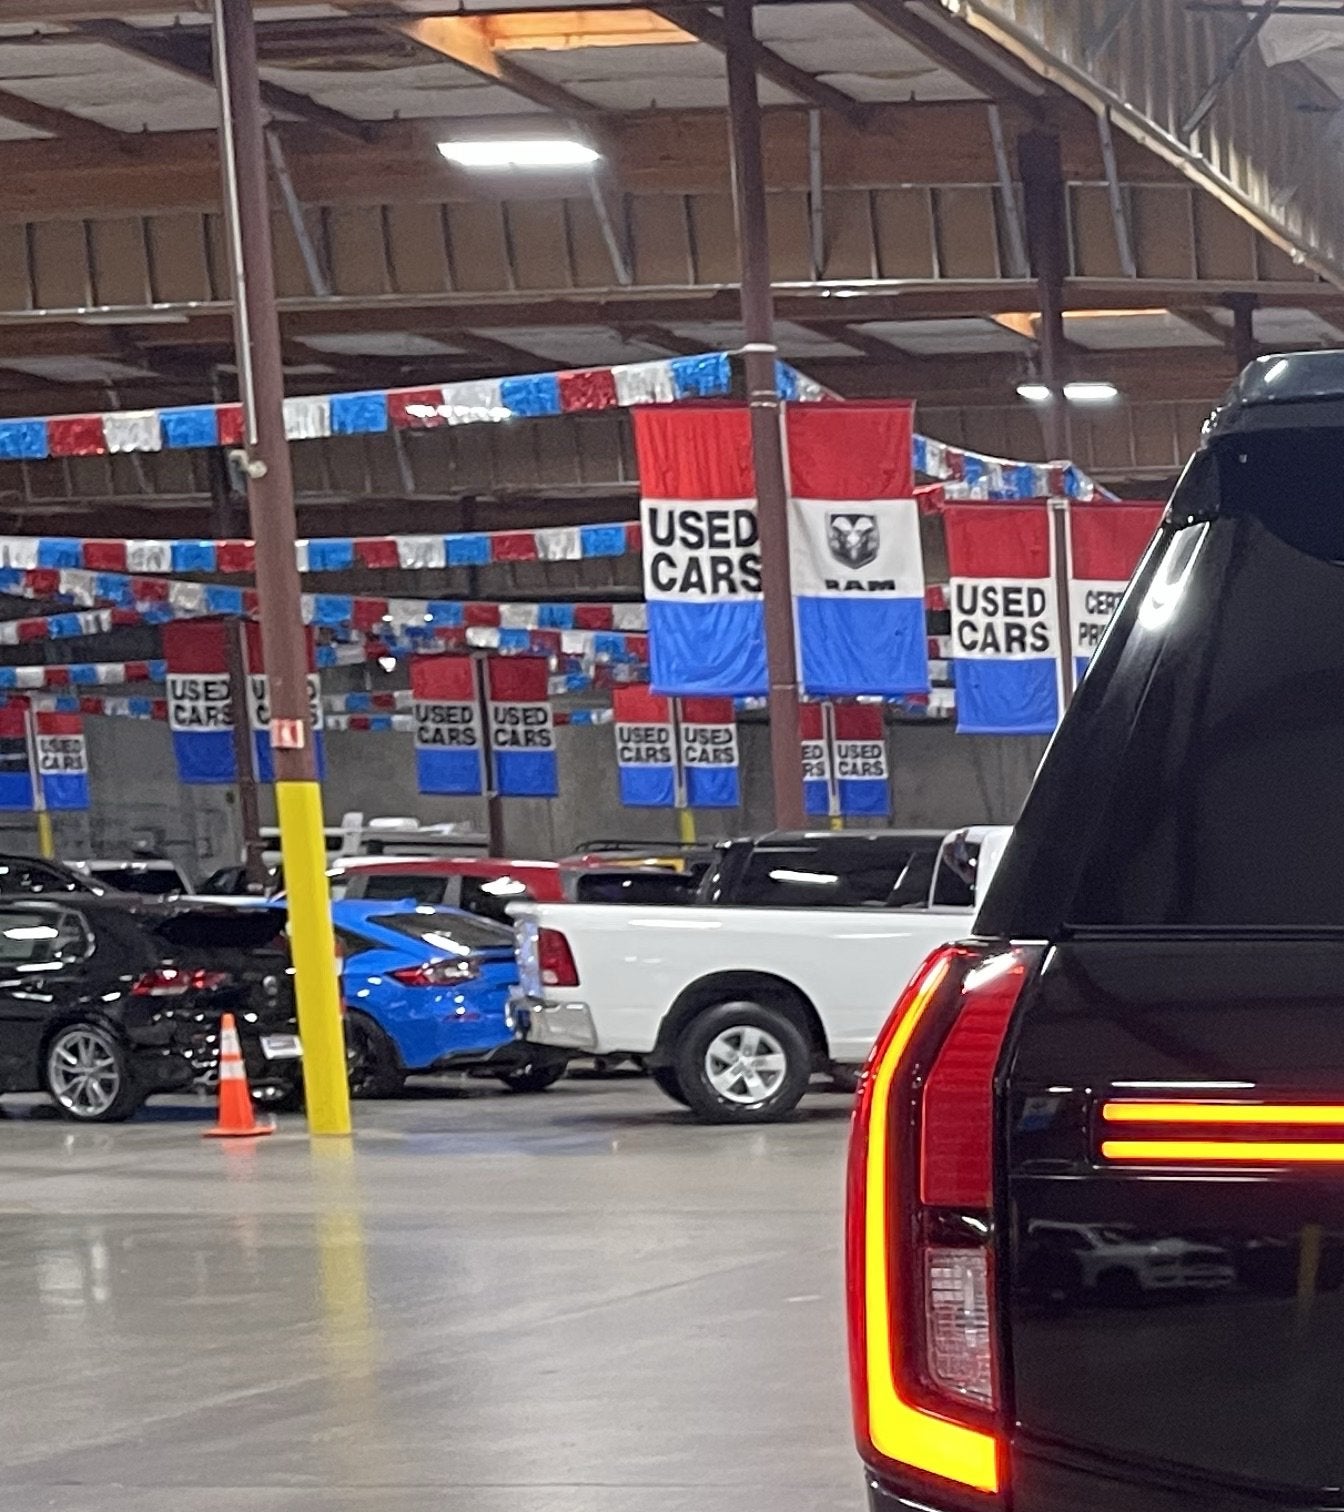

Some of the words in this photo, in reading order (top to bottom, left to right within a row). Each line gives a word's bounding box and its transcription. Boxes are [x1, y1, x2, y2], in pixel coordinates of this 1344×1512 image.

[649, 508, 759, 549] USED
[651, 552, 762, 594] CARS
[956, 584, 1046, 618] USED
[957, 620, 1050, 653] CARS
[171, 680, 231, 701] USED
[174, 704, 234, 726] CARS
[415, 704, 473, 724] USED
[494, 707, 548, 726] USED
[417, 726, 476, 745] CARS
[494, 729, 551, 747] CARS
[619, 727, 669, 744] USED
[684, 727, 733, 745] USED
[619, 746, 671, 763] CARS
[685, 747, 734, 763] CARS
[838, 745, 882, 760] USED
[839, 761, 884, 777] CARS
